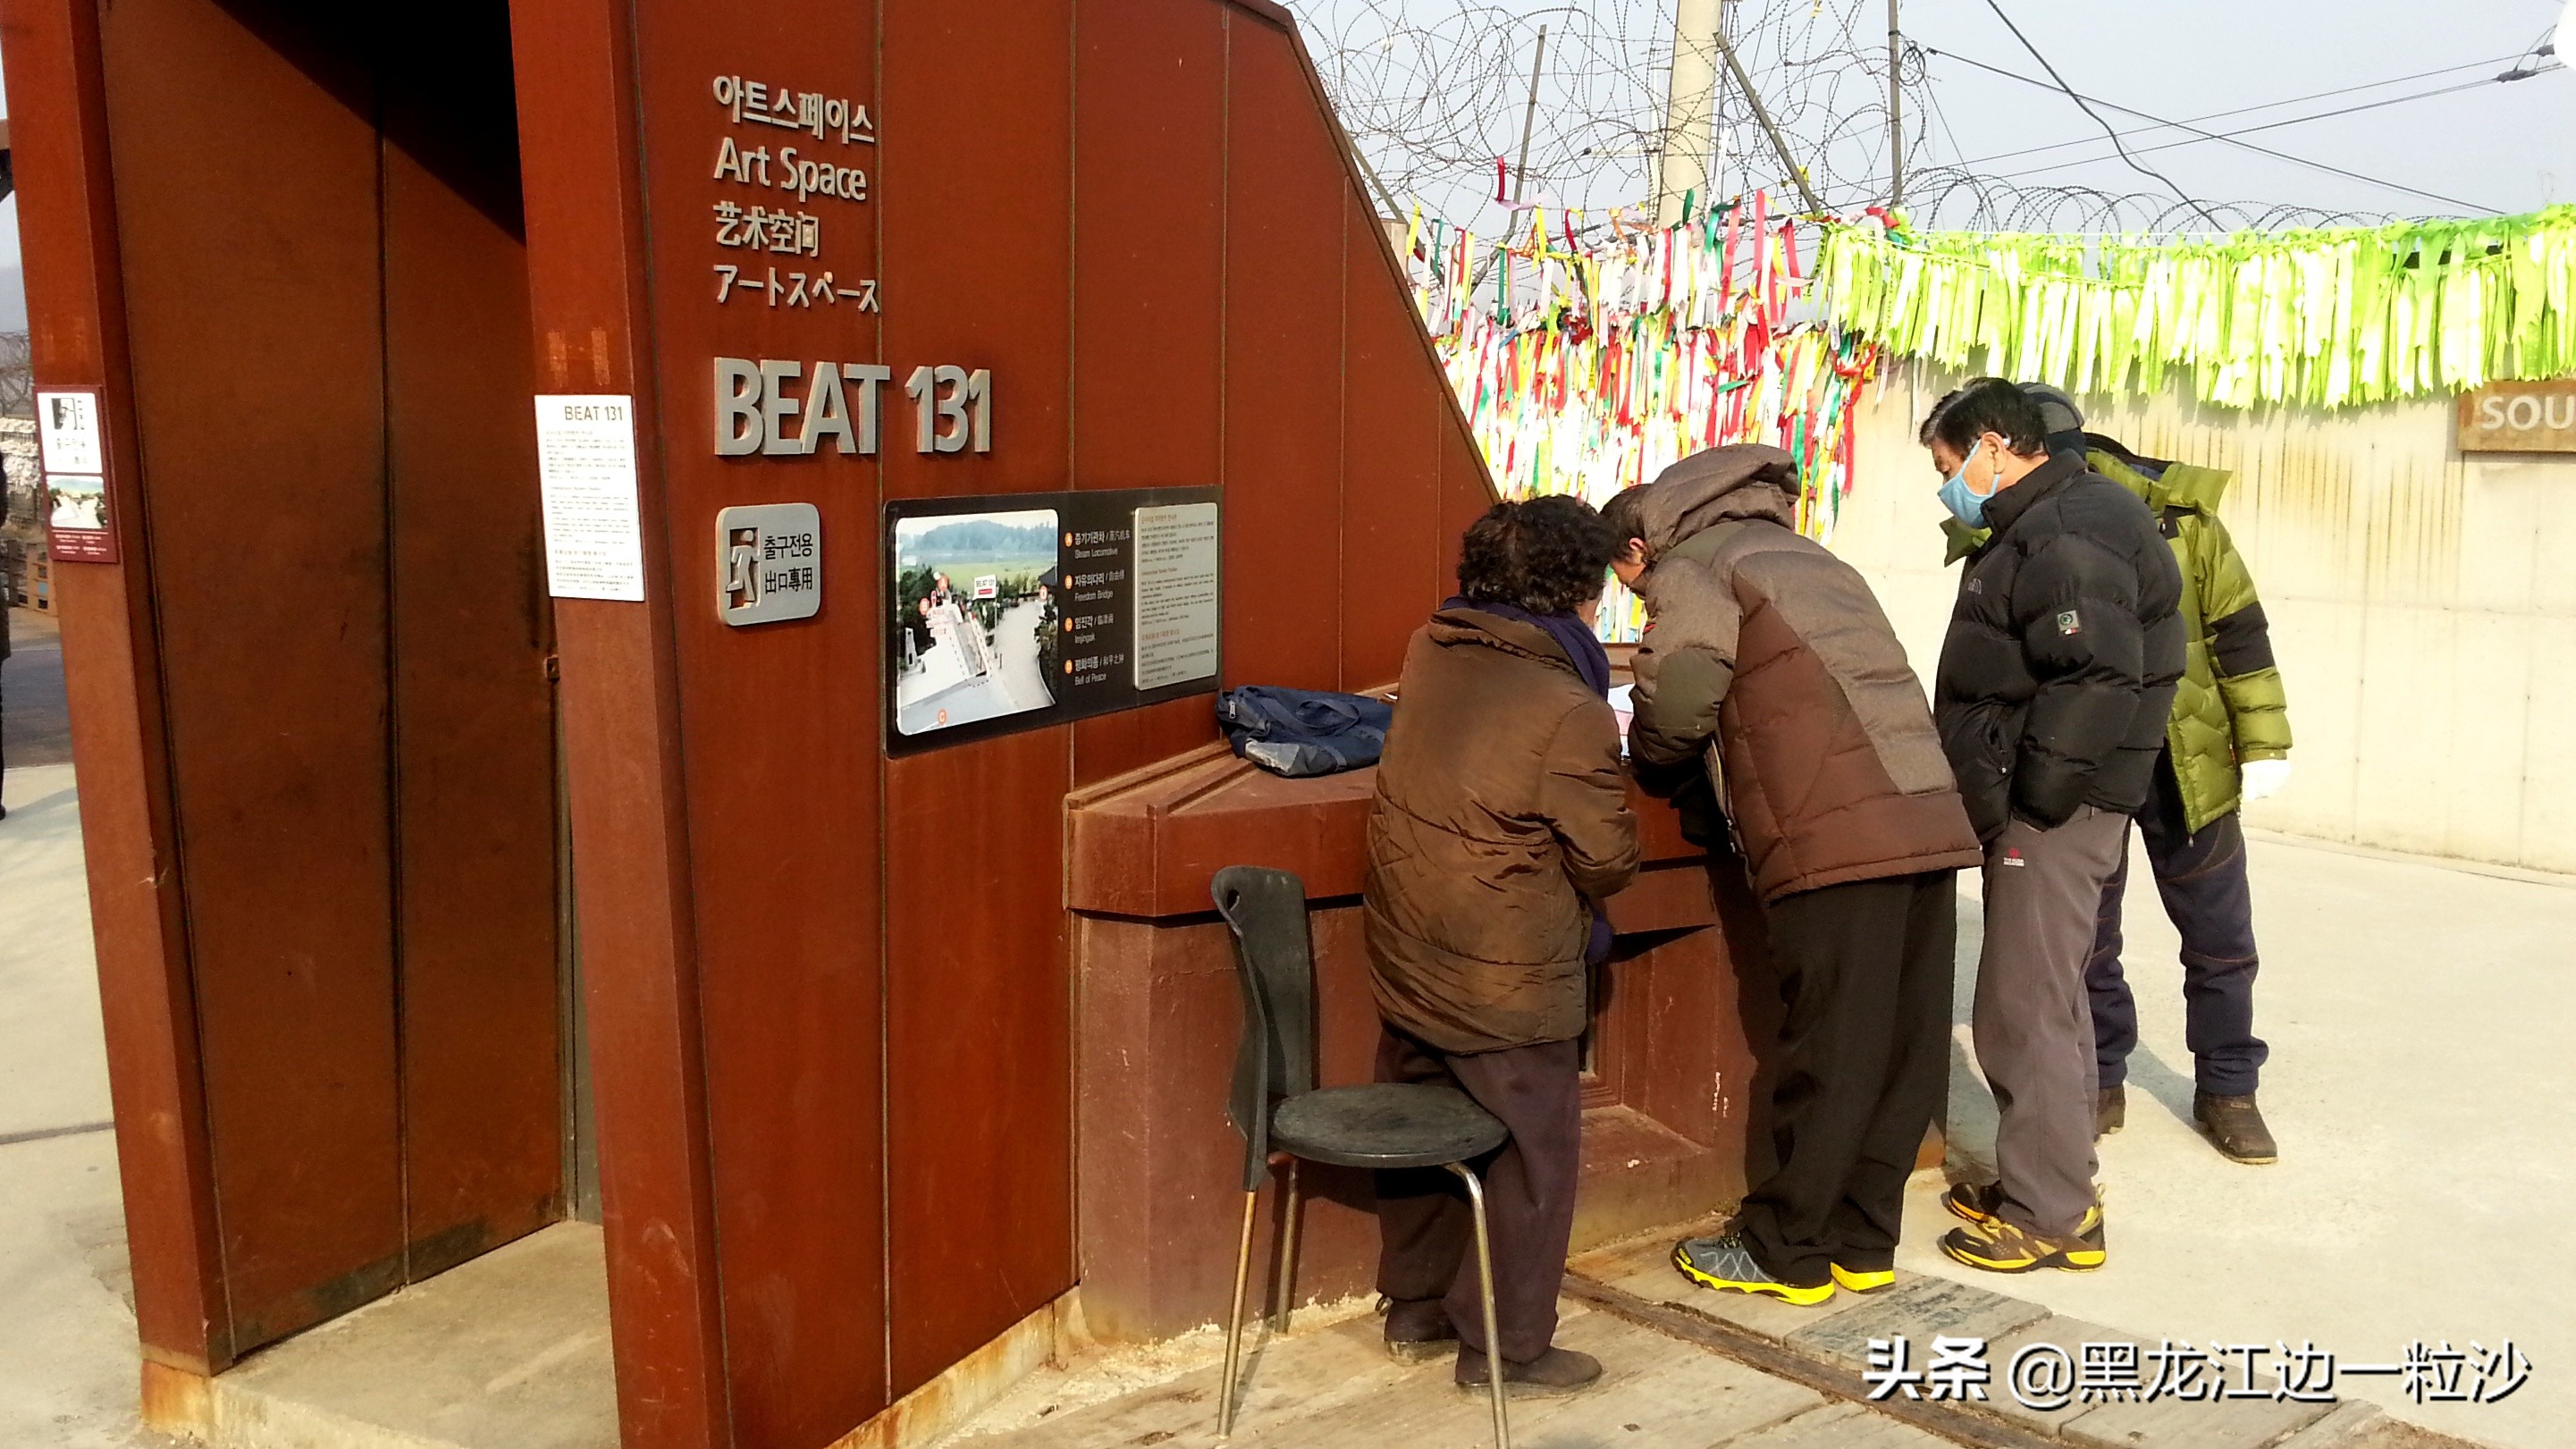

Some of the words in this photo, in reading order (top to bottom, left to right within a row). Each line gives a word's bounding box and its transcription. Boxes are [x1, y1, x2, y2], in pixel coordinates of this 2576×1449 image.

[713, 75, 875, 144] 아트스페이스
[713, 137, 770, 186] Art
[779, 147, 867, 202] Space
[713, 200, 820, 257] 艺术空间
[713, 265, 880, 313] アートスペース
[564, 405, 600, 420] BEAT
[604, 406, 623, 421] 131
[714, 357, 890, 455] BEAT
[905, 365, 991, 453] 131
[2481, 394, 2576, 431] SOU
[764, 533, 813, 560] 출구전용
